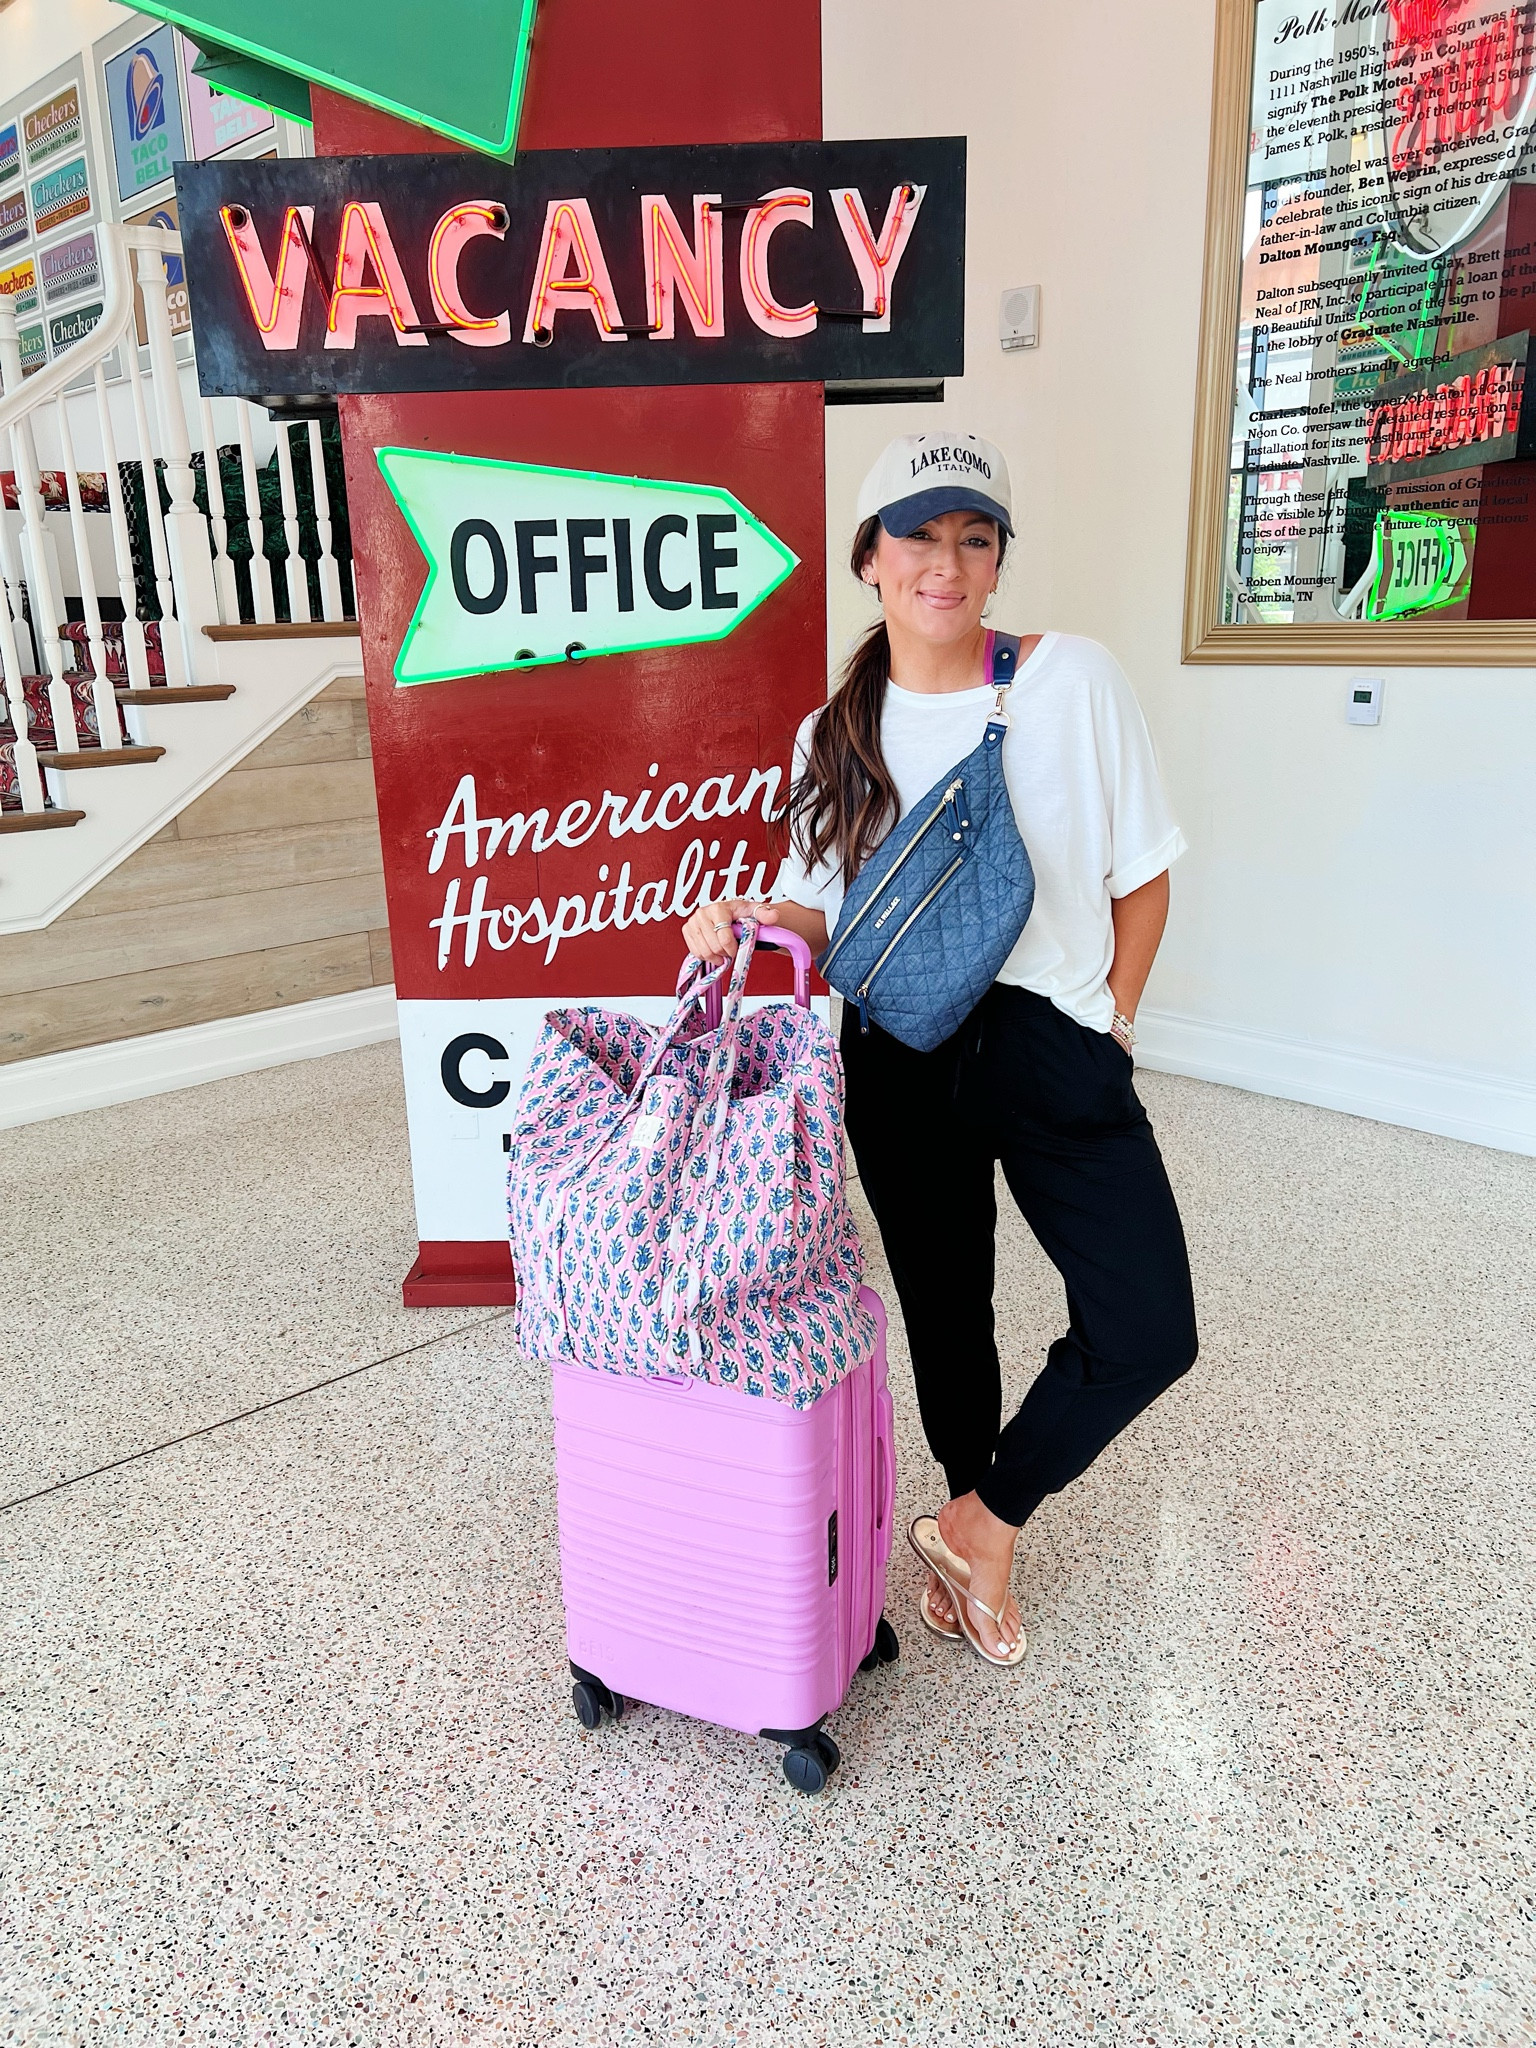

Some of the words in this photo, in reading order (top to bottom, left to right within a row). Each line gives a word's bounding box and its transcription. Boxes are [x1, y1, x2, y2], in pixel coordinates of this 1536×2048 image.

[1273, 8, 1331, 44] Polk
[1269, 64, 1311, 82] During
[1314, 58, 1334, 70] the
[1338, 45, 1379, 64] 1950's,
[1382, 38, 1407, 52] this
[1408, 28, 1442, 46] neon
[1446, 19, 1476, 36] sign
[1479, 10, 1507, 26] was
[1267, 100, 1307, 120] signify
[1311, 94, 1336, 108] The
[1339, 84, 1369, 101] Polk
[1372, 73, 1416, 93] Motel,
[1420, 59, 1460, 82] which
[1464, 55, 1489, 73] was
[1270, 84, 1295, 100] 1111
[1300, 69, 1357, 93] Nashville
[1360, 53, 1416, 77] Highway
[1420, 49, 1433, 62] in
[26, 98, 77, 140] Checkers
[1266, 126, 1285, 138] the
[1288, 111, 1340, 132] eleventh
[1343, 94, 1404, 122] president
[1407, 90, 1421, 104] of
[1424, 86, 1445, 100] the
[1449, 74, 1495, 94] United
[213, 111, 259, 147] BELL
[1264, 140, 1300, 160] James
[1303, 135, 1315, 147] K.
[1317, 128, 1348, 144] Polk,
[1350, 127, 1358, 136] a
[1360, 113, 1414, 134] resident
[1417, 107, 1431, 120] of
[1433, 101, 1456, 115] the
[130, 132, 170, 166] TACO
[1264, 175, 1302, 192] Before
[1305, 169, 1327, 182] this
[1330, 160, 1361, 177] hotel
[1364, 155, 1389, 169] was
[1392, 148, 1423, 164] ever
[1424, 130, 1499, 157] conceived,
[34, 171, 85, 208] Checkers
[134, 157, 173, 187] BELL
[1304, 182, 1355, 202] founder,
[1358, 176, 1385, 190] Ben
[1387, 164, 1440, 183] Weprin,
[1443, 145, 1516, 172] expressed
[1275, 204, 1333, 226] celebrate
[1336, 199, 1358, 213] this
[1361, 190, 1400, 209] iconic
[1403, 184, 1431, 200] sign
[1434, 179, 1449, 193] of
[1451, 176, 1471, 190] his
[1474, 164, 1528, 185] dreams
[1260, 222, 1337, 247] father-in-law
[1339, 215, 1362, 231] and
[1366, 203, 1430, 225] Columbia
[1433, 195, 1481, 213] citizen,
[43, 245, 94, 278] Checkers
[218, 184, 928, 351] VACANCY
[1259, 248, 1301, 265] Dalton
[1304, 237, 1368, 256] Mounger,
[1255, 305, 1282, 319] Neal
[1285, 301, 1298, 314] of
[1298, 297, 1324, 315] JRN,
[1351, 292, 1363, 304] to
[1366, 280, 1437, 304] participate
[1440, 275, 1453, 288] in
[1456, 276, 1464, 286] a
[1468, 271, 1498, 284] loan
[1501, 264, 1517, 278] of
[1256, 287, 1295, 302] Dalton
[1297, 270, 1380, 294] subsequently
[1382, 260, 1428, 280] invited
[1431, 257, 1465, 271] Clay,
[1467, 250, 1500, 265] Brett
[1503, 243, 1531, 259] and
[1270, 315, 1322, 334] Beautiful
[1325, 310, 1356, 325] Units
[1359, 304, 1405, 323] portion
[1409, 298, 1425, 312] of
[1425, 297, 1446, 310] the
[1449, 292, 1478, 307] sign
[1482, 289, 1496, 301] to
[1499, 285, 1518, 298] be
[1267, 339, 1286, 352] the
[1288, 334, 1323, 348] lobby
[1326, 330, 1339, 342] of
[1340, 322, 1403, 340] Graduate
[1406, 310, 1480, 331] Nashville.
[1252, 376, 1273, 388] The
[1275, 372, 1303, 385] Neal
[1305, 365, 1357, 381] brothers
[1360, 359, 1399, 374] kindly
[1403, 350, 1454, 369] agreed.
[1249, 408, 1297, 422] Charles
[1299, 402, 1339, 416] Stofel,
[1341, 399, 1361, 412] the
[1363, 387, 1466, 409] owner/operator
[1469, 384, 1486, 397] of
[1247, 427, 1278, 440] Neon
[1280, 424, 1300, 437] Co.
[1302, 420, 1352, 434] oversaw
[1355, 416, 1374, 428] the
[1247, 441, 1309, 456] installation
[1311, 439, 1330, 450] for
[1331, 437, 1346, 448] its
[1349, 433, 1393, 446] newest
[1395, 429, 1431, 441] home
[911, 446, 951, 478] LAKE
[953, 447, 992, 480] COMO
[937, 463, 971, 474] ITALY
[1246, 459, 1302, 473] Graduate
[1302, 453, 1361, 468] Nashville.
[1243, 511, 1274, 522] made
[1277, 507, 1316, 521] visible
[1318, 507, 1333, 520] by
[1393, 497, 1459, 512] authentic
[1462, 495, 1488, 508] and
[1244, 493, 1291, 507] Through
[1294, 490, 1325, 502] these
[1396, 482, 1446, 495] mission
[1448, 478, 1463, 491] of
[1242, 528, 1272, 539] relics
[1275, 526, 1288, 537] of
[1288, 525, 1306, 536] the
[1308, 524, 1334, 537] past
[1384, 519, 1421, 531] future
[1425, 517, 1444, 528] for
[449, 513, 740, 616] OFFICE
[1241, 545, 1251, 555] to
[1254, 544, 1287, 556] enjoy.
[1238, 591, 1295, 604] Columbia,
[1297, 591, 1313, 602] TN
[1246, 576, 1281, 587] Roben
[1283, 575, 1338, 588] Mounger
[426, 762, 787, 874] American
